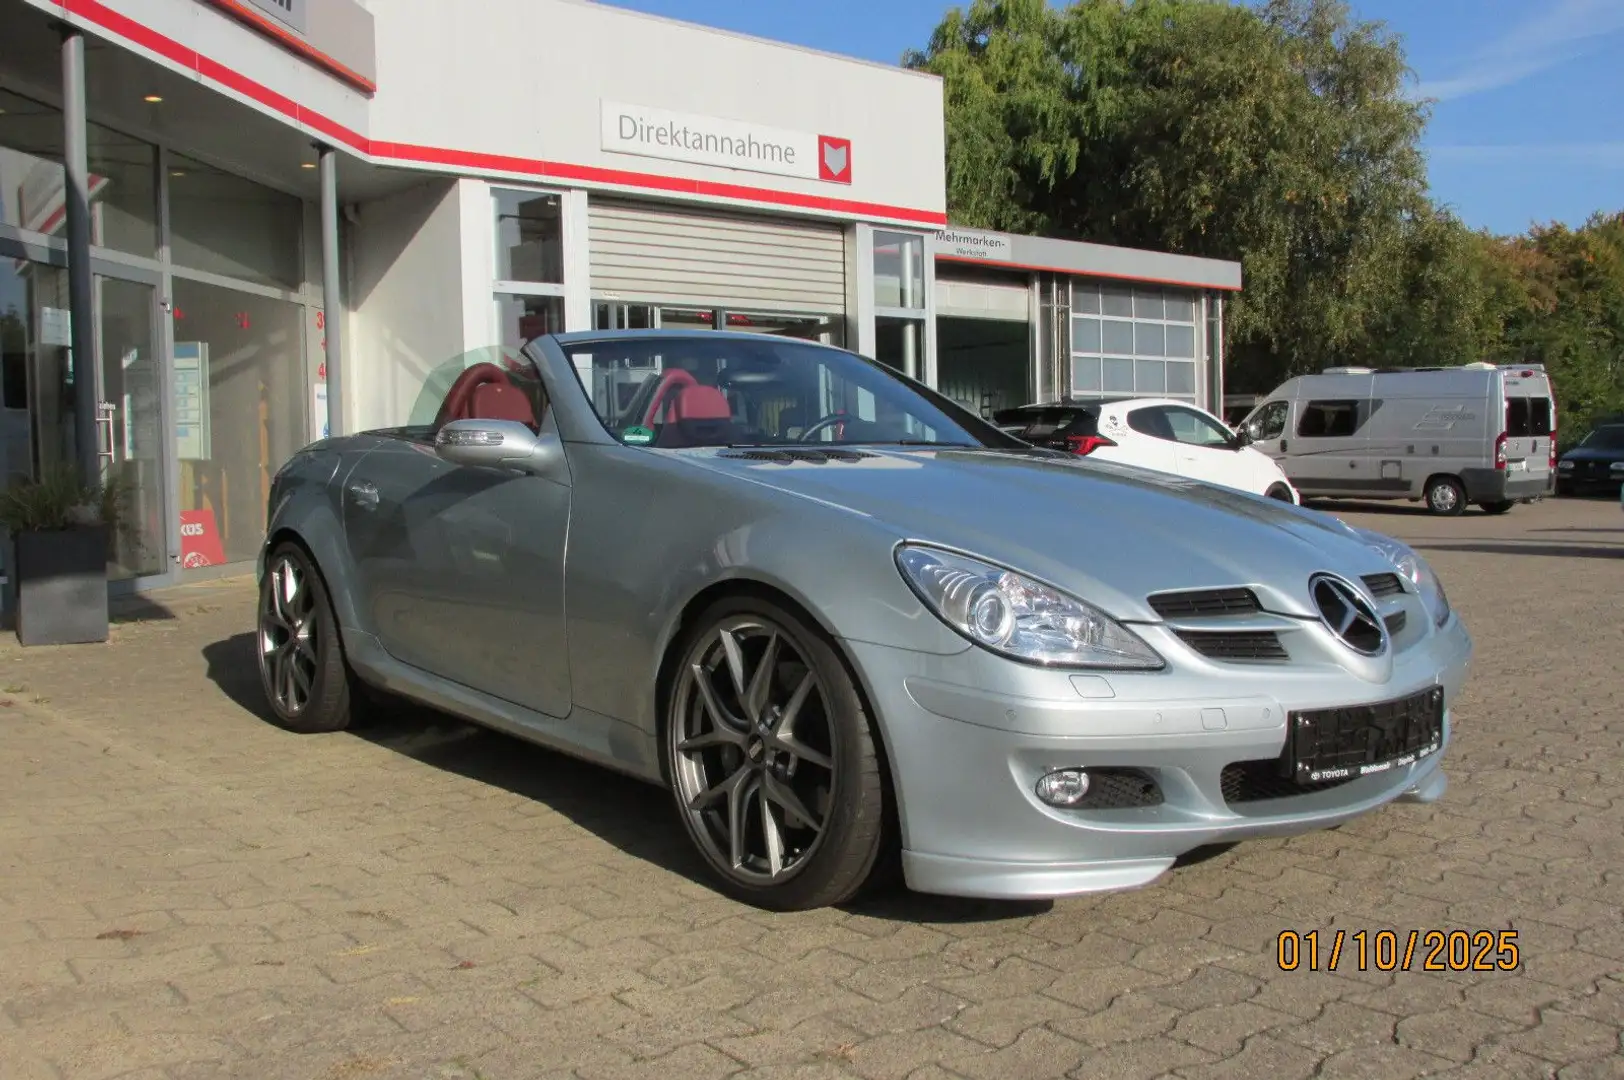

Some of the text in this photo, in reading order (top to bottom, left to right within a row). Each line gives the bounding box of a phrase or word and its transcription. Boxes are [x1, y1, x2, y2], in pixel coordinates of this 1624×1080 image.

[619, 115, 795, 164] Direktannahme
[935, 230, 1005, 247] Mehrmarken-
[1322, 769, 1349, 779] TOYOTA
